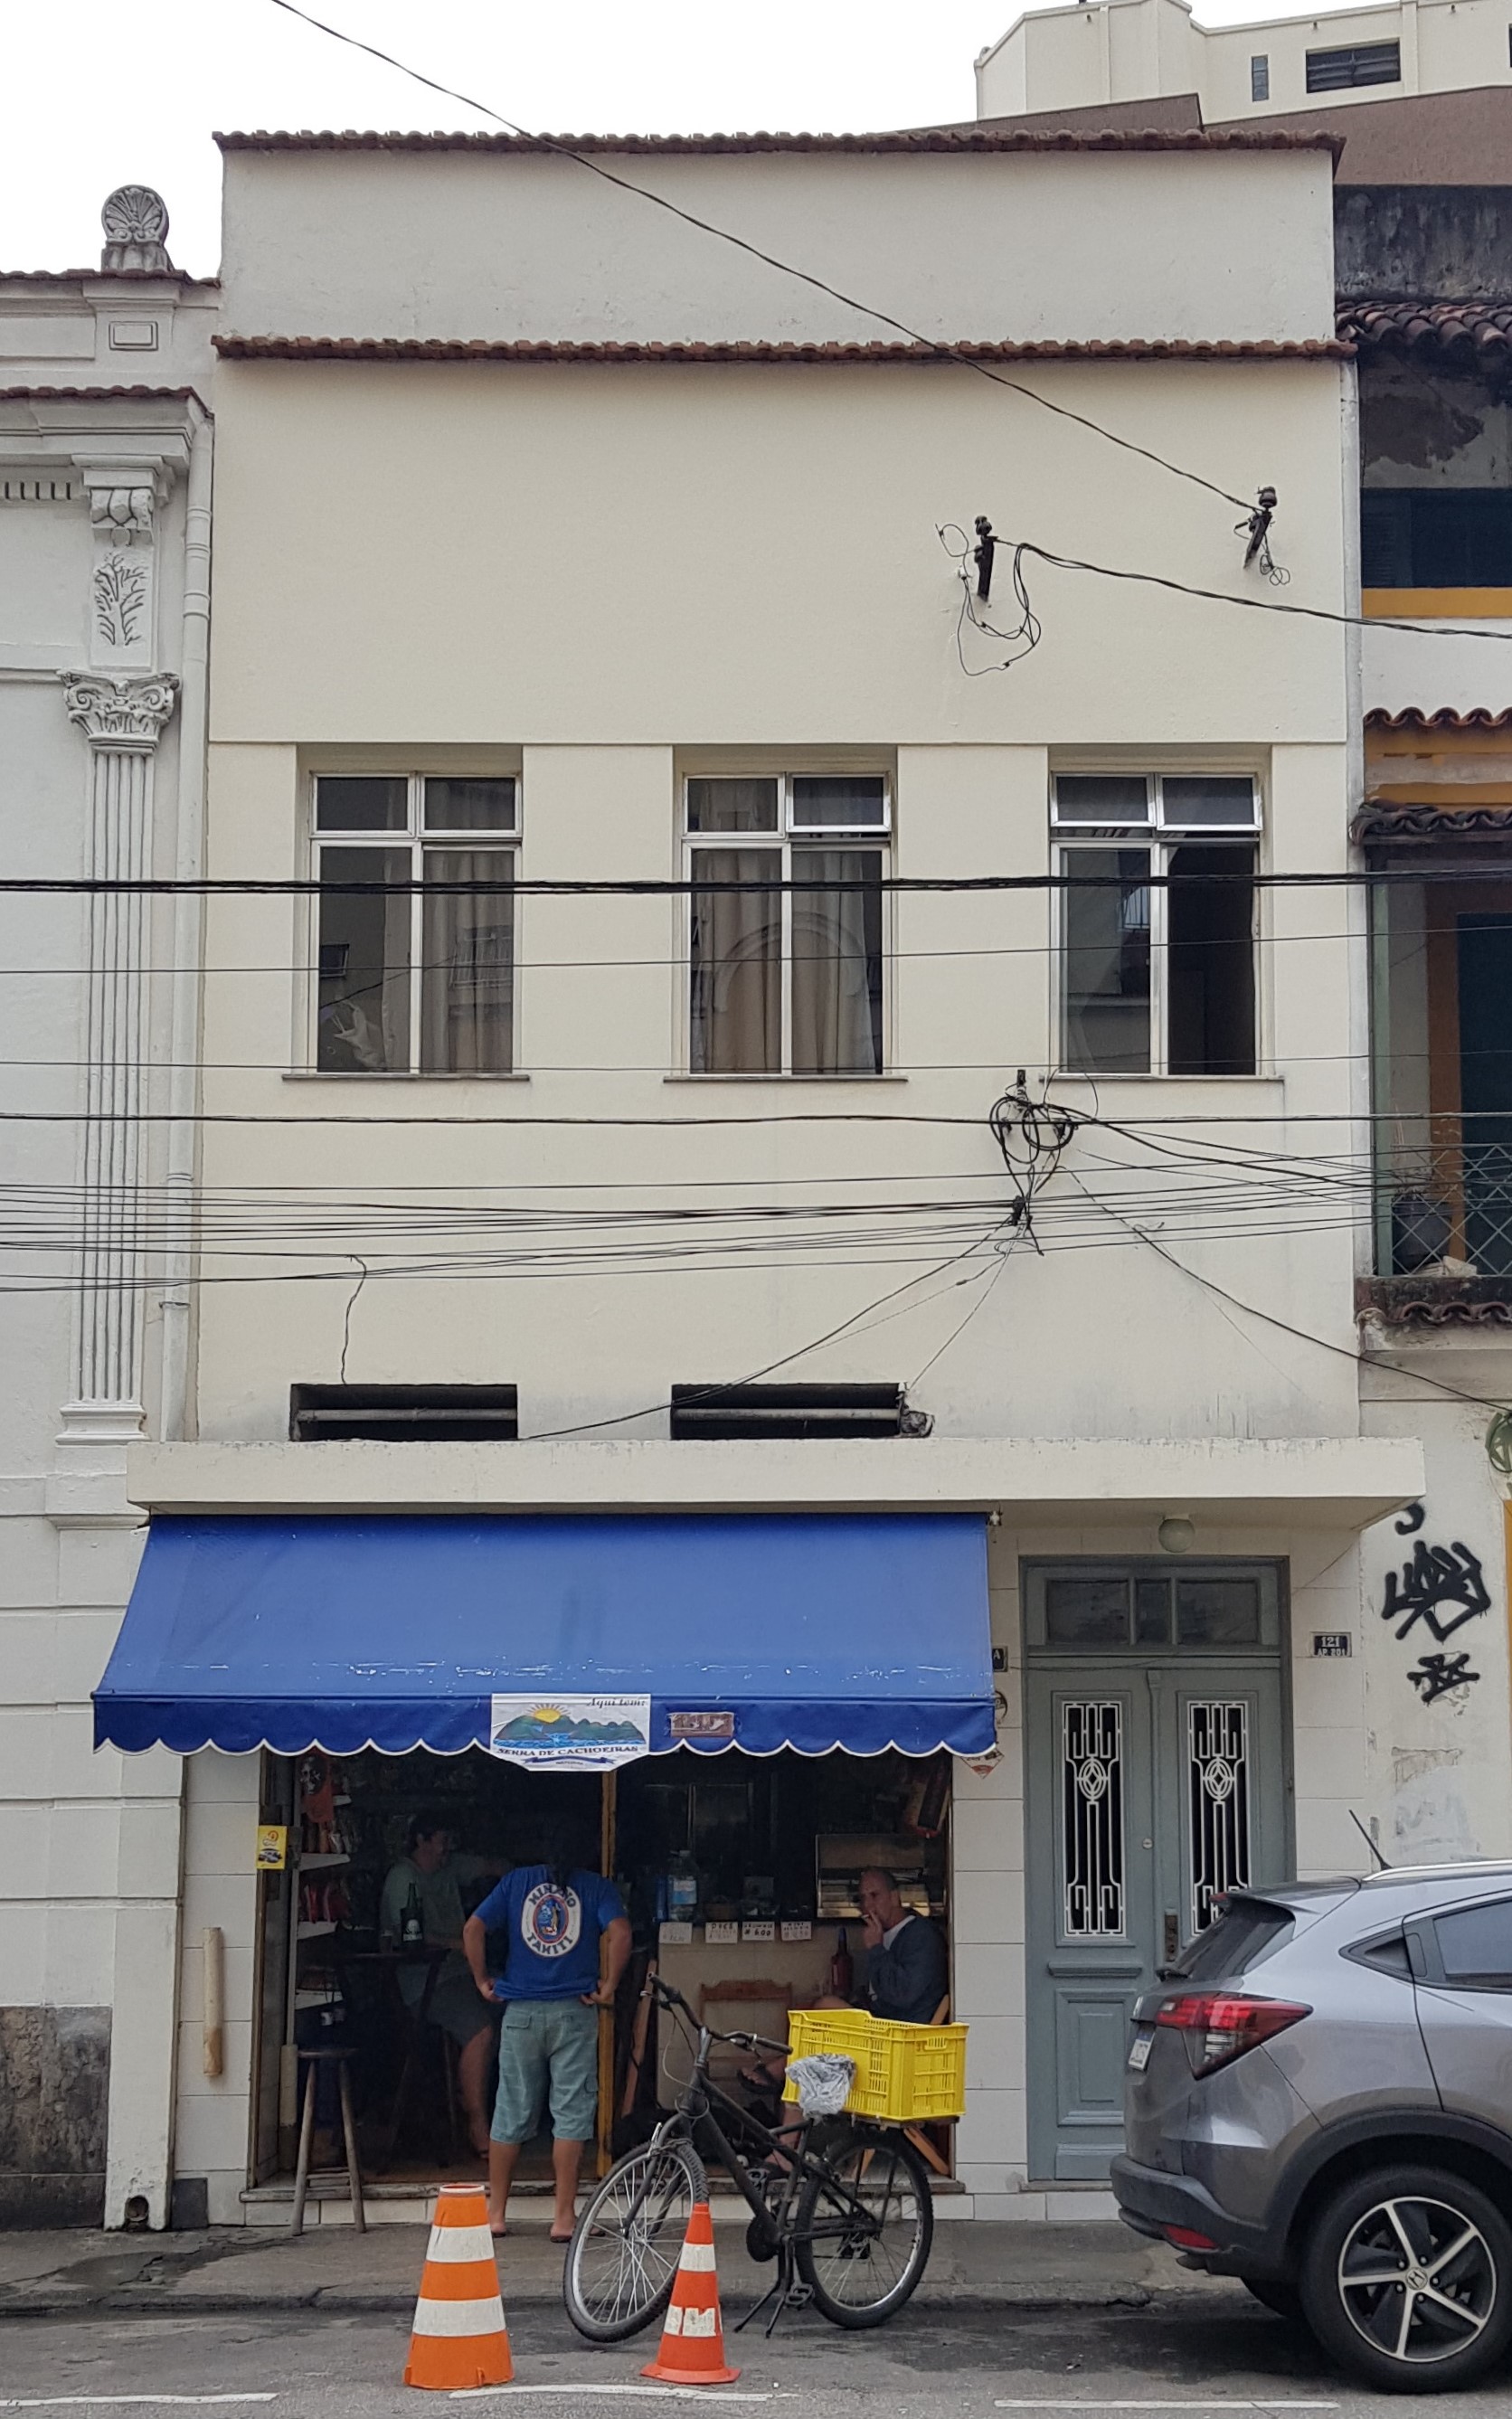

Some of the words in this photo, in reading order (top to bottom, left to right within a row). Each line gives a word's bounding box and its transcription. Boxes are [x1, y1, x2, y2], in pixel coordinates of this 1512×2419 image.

[1321, 1636, 1340, 1648] 121
[496, 1748, 536, 1756] SERRA
[558, 1745, 638, 1755] CACHOEIRAS
[526, 1932, 573, 1955] TAHITI
